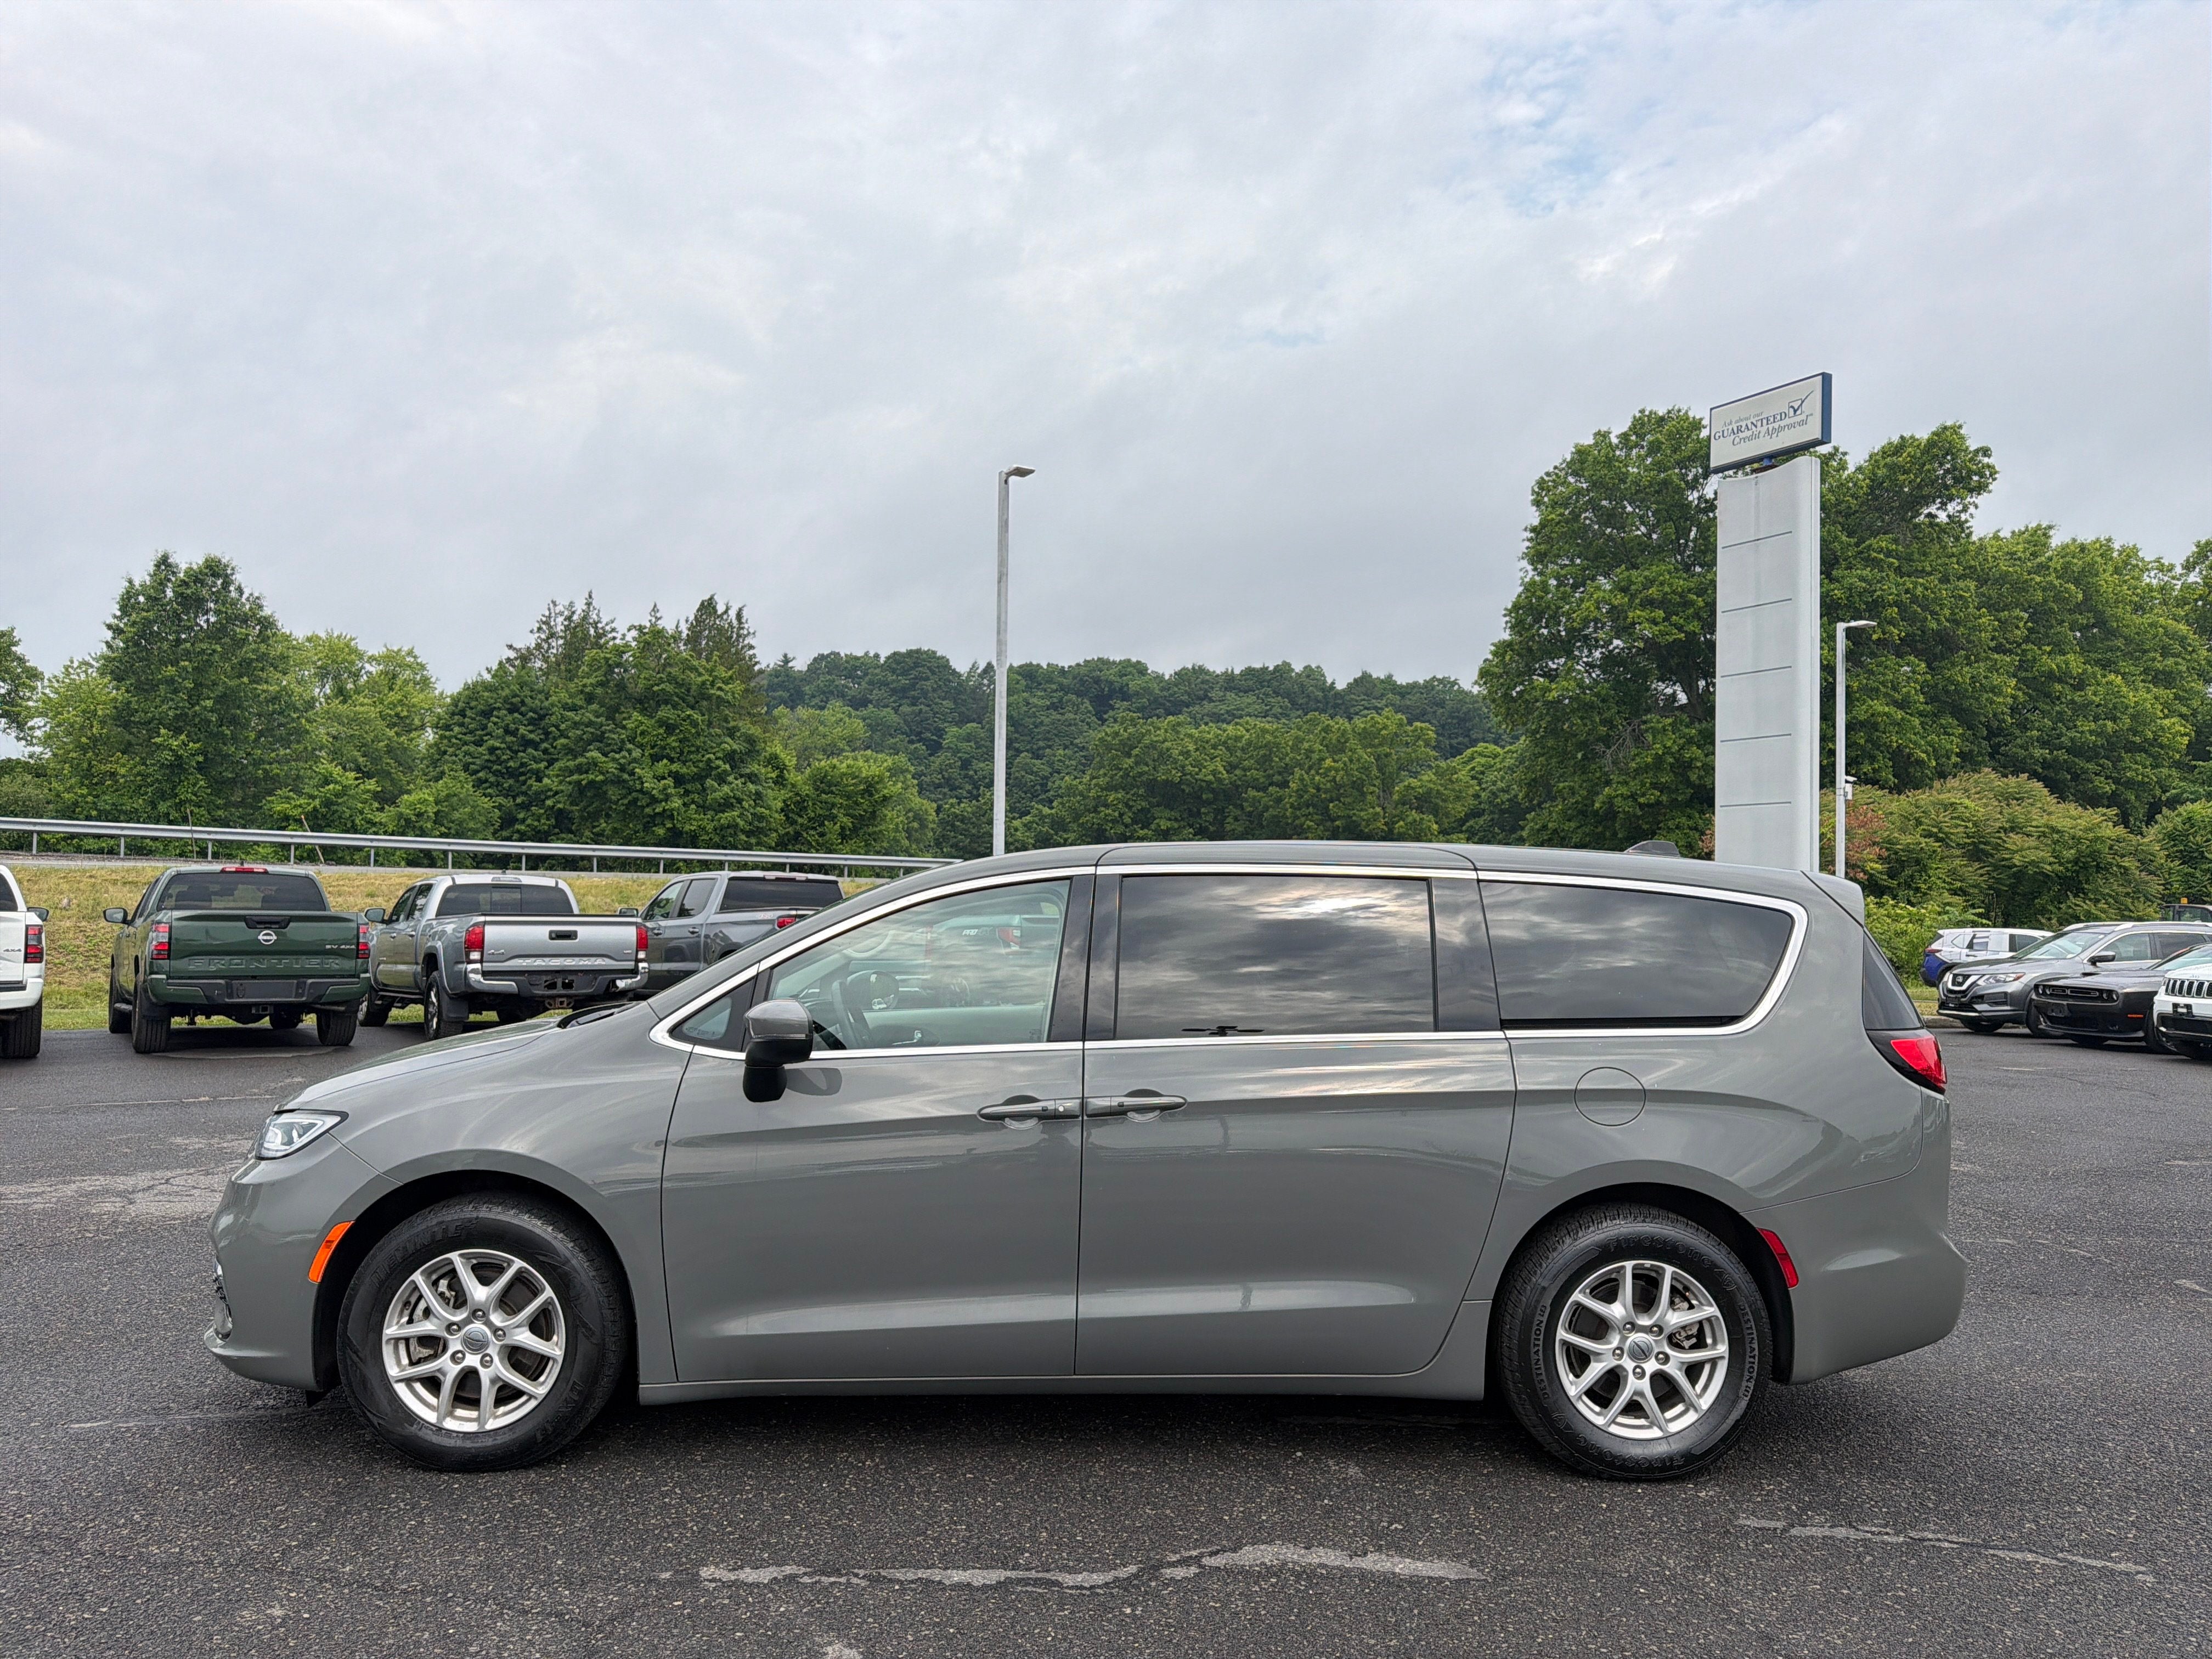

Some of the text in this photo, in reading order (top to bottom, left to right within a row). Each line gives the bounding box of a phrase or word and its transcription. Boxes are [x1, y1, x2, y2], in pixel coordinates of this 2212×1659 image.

[1714, 411, 1787, 440] GUARANTEED
[1722, 411, 1764, 428] Ask about our
[1732, 415, 1808, 446] Credit Approval
[189, 959, 340, 970] FRONTIER
[1606, 1234, 1715, 1268] Firestone
[1738, 1303, 1758, 1384] DESTINATION
[1532, 1319, 1550, 1400] DESTINATION
